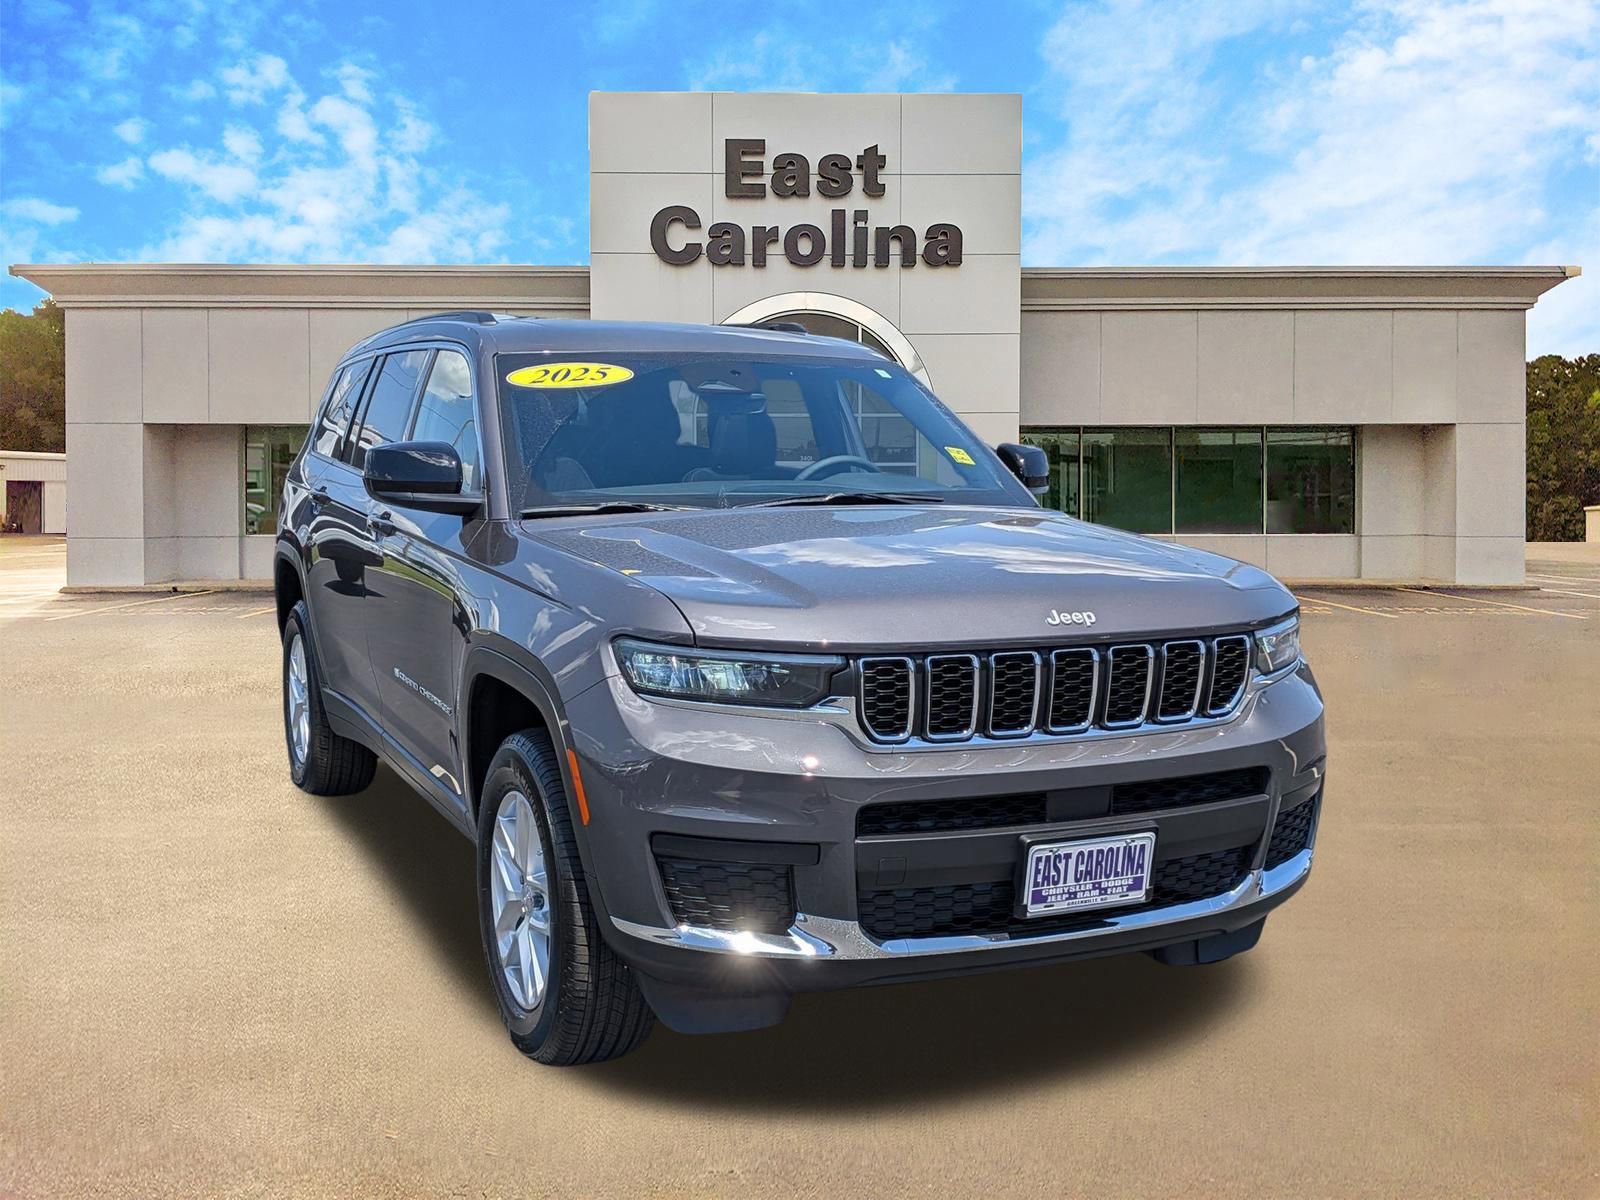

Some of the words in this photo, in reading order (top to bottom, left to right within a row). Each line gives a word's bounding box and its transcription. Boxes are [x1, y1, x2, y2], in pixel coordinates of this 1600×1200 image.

[725, 138, 886, 199] East
[650, 205, 963, 267] Carolina
[530, 367, 611, 384] 2025
[1045, 609, 1096, 626] Jeep
[1033, 852, 1073, 888] EAST
[1074, 843, 1146, 886] CAROLINA
[1042, 883, 1093, 896] CHRYSLER
[1101, 878, 1134, 889] DODGE
[1046, 893, 1070, 903] JEEP
[1076, 889, 1100, 899] RAM
[1107, 885, 1129, 895] FIAT
